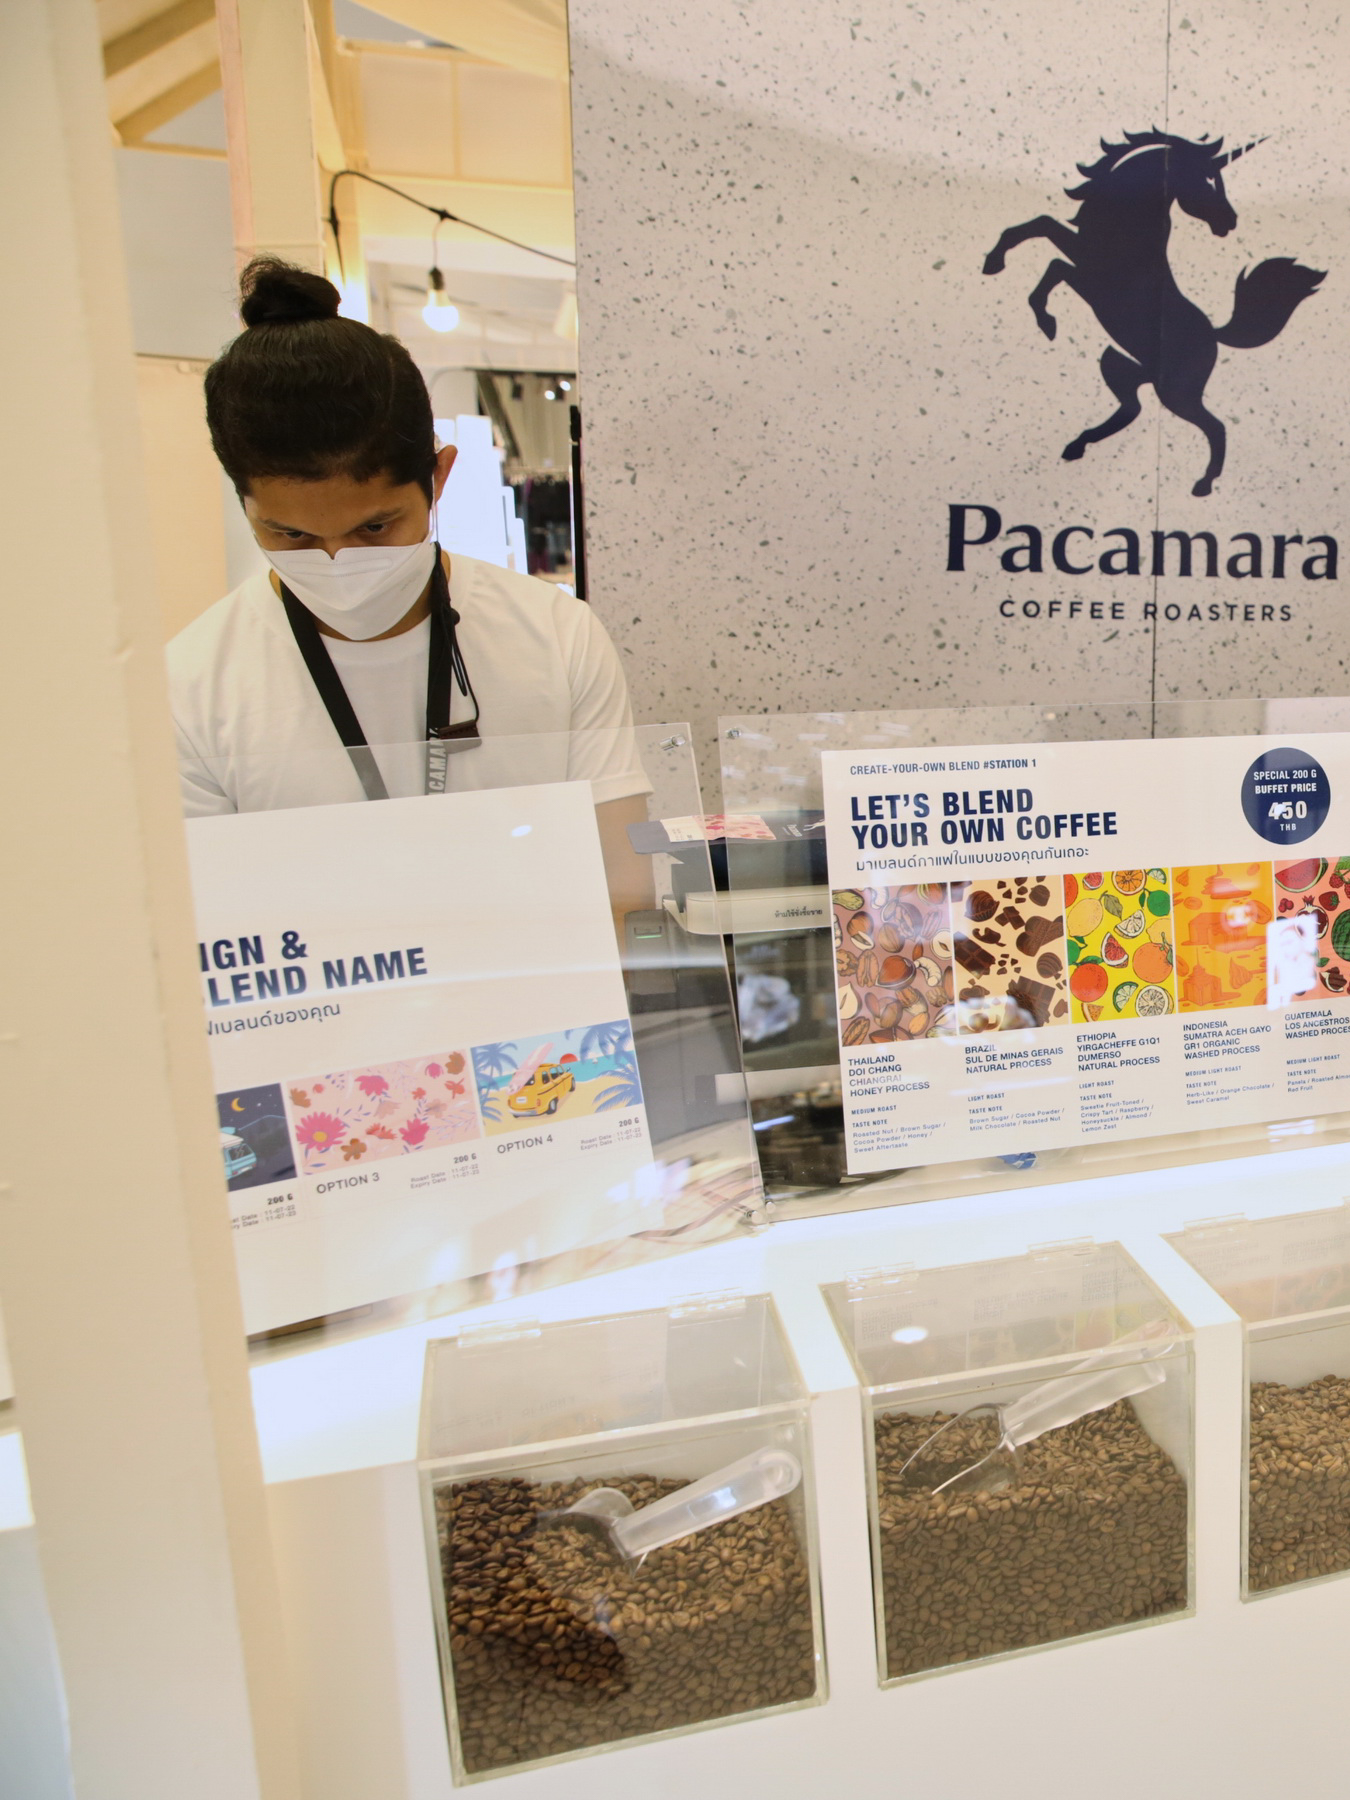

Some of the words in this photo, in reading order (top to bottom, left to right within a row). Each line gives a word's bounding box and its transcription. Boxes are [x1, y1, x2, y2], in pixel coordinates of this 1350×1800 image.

[945, 503, 1338, 580] Pacamara
[999, 600, 1124, 619] COFFEE
[1144, 603, 1291, 621] ROASTERS
[850, 762, 945, 775] CREATE-YOUR-OWN
[949, 761, 980, 771] BLEND
[983, 759, 1028, 770] #STATION
[1032, 758, 1036, 767] 1
[1253, 770, 1289, 780] SPECIAL
[1292, 769, 1308, 779] 200
[1311, 769, 1316, 778] G
[1255, 784, 1288, 794] BUFFET
[1291, 782, 1316, 792] PRICE
[943, 788, 1033, 816] BLEND
[1268, 800, 1307, 819] 450
[851, 821, 928, 849] YOUR
[941, 817, 1004, 844] OWN
[1016, 812, 1117, 840] COFFEE
[1279, 823, 1296, 831] THB
[856, 846, 1089, 871] มาเบลนด์กาแฟในแบบของคุณกันเถอะ
[198, 935, 264, 972] IGN
[281, 930, 308, 960] &
[322, 947, 427, 989] NAME
[1285, 1010, 1332, 1021] GUATEMALA
[1183, 1020, 1228, 1031] INDONESIA
[1285, 1021, 1300, 1030] LOS
[1302, 1017, 1350, 1028] ANCESTROS
[1076, 1032, 1116, 1042] ETHIOPIA
[1183, 1031, 1223, 1041] SUMATRA
[1225, 1028, 1247, 1037] ACEH
[1249, 1025, 1271, 1034] GAYO
[1285, 1029, 1319, 1039] WASHED
[965, 1044, 997, 1054] BRAZIL
[1077, 1040, 1136, 1052] YIRGACHEFFE
[1139, 1037, 1160, 1045] G1Q1
[1184, 1041, 1200, 1051] GR1
[1202, 1038, 1240, 1048] ORGANIC
[965, 1054, 983, 1064] SUL
[985, 1054, 997, 1062] DE
[1000, 1050, 1028, 1060] MINAS
[1031, 1047, 1063, 1057] GERAIS
[1078, 1050, 1121, 1062] DUMERSO
[1184, 1049, 1219, 1060] WASHED
[1222, 1045, 1260, 1056] PROCESS
[848, 1054, 895, 1066] THAILAND
[966, 1063, 1007, 1074] NATURAL
[1009, 1058, 1052, 1069] PROCESS
[1078, 1059, 1117, 1071] NATURAL
[1120, 1056, 1160, 1067] PROCESS
[1286, 1057, 1306, 1065] MEDIUM
[848, 1067, 865, 1076] DOI
[868, 1064, 902, 1074] CHANG
[849, 1074, 902, 1086] CHIANGRAI
[1311, 1075, 1334, 1083] Roasted
[850, 1086, 883, 1097] HONEY
[886, 1081, 929, 1093] PROCESS
[1220, 1086, 1241, 1094] Orange
[1242, 1083, 1269, 1091] Chocolate
[968, 1094, 984, 1102] LIGHT
[851, 1107, 875, 1115] MEDIUM
[1081, 1110, 1100, 1119] Crispy
[1119, 1105, 1149, 1114] Raspberry
[618, 1119, 634, 1127] 200
[985, 1121, 1016, 1129] Chocolate
[1022, 1117, 1048, 1125] Roasted
[991, 1114, 1009, 1122] Sugar
[1081, 1116, 1119, 1125] Honeysuckle
[1125, 1112, 1147, 1120] Almond
[853, 1129, 880, 1138] Roasted
[922, 1122, 941, 1130] Sugar
[497, 1136, 543, 1154] OPTION
[546, 1134, 553, 1143] 4
[853, 1138, 874, 1146] Cocoa
[876, 1135, 901, 1143] Powder
[453, 1155, 468, 1164] 200
[316, 1175, 368, 1194] OPTION
[372, 1172, 380, 1181] 3
